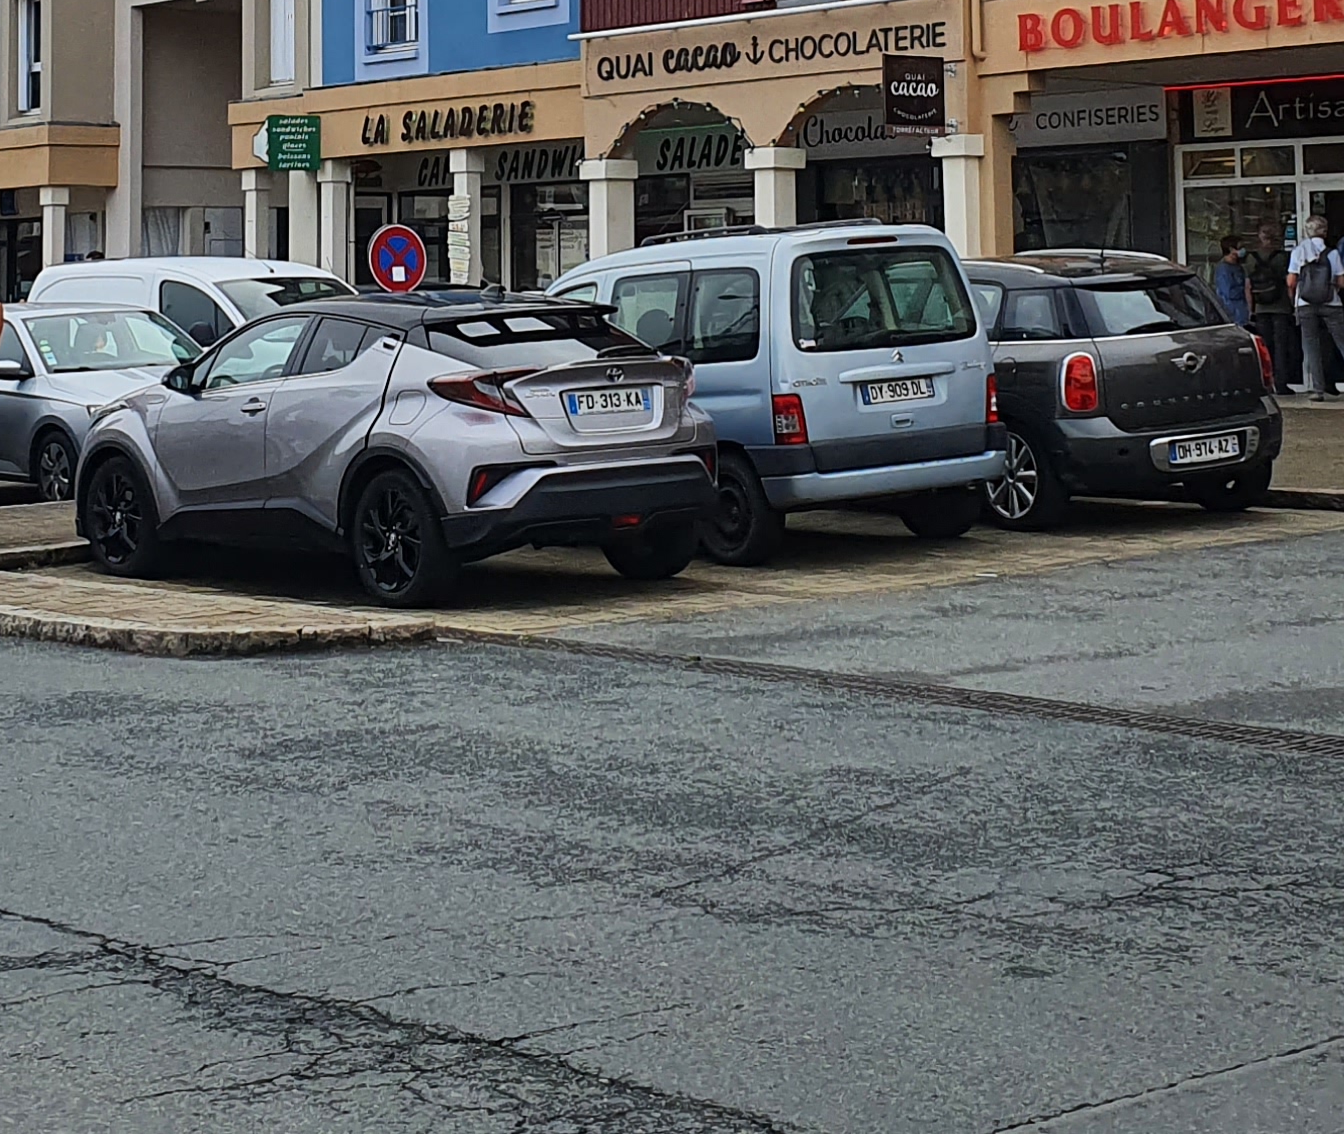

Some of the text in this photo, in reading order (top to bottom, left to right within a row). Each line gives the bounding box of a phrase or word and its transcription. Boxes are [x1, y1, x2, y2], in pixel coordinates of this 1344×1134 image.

[597, 21, 948, 82] QUAI cacao CHOCOLATERIE
[890, 81, 940, 98] cacao
[904, 72, 926, 81] QUAI
[361, 100, 535, 146] LA SALADERIE
[803, 115, 896, 148] Chocola
[1035, 104, 1160, 130] CONFISERIES
[494, 145, 580, 182] SANDWI
[577, 391, 642, 410] FD-313-KA
